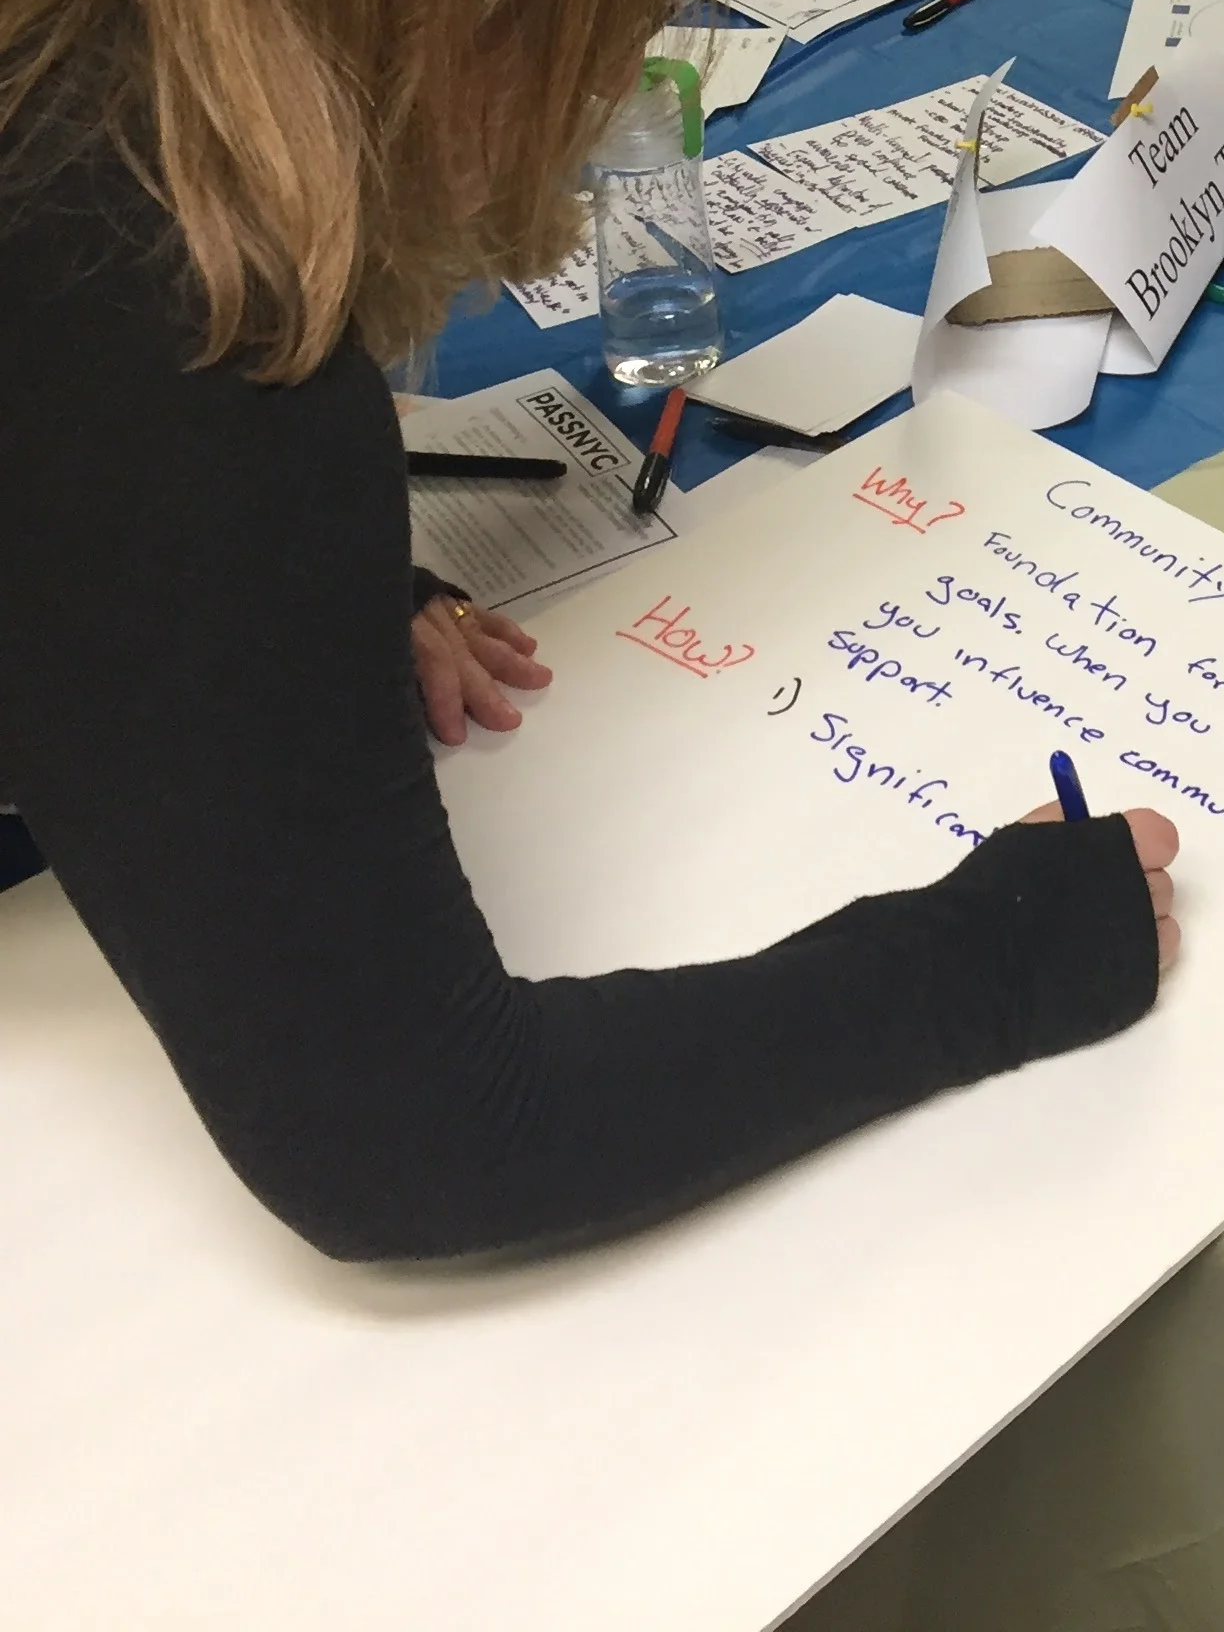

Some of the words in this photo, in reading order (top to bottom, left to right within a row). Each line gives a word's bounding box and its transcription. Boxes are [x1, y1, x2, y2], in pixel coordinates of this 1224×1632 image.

[1128, 105, 1200, 189] Team
[527, 390, 621, 472] PASSNYC
[854, 465, 966, 529] Why?
[630, 594, 756, 675] How?
[982, 530, 1158, 657] Foundation
[863, 599, 941, 641] you
[955, 647, 1107, 746] influence
[1045, 633, 1130, 693] when
[1145, 689, 1212, 737] you
